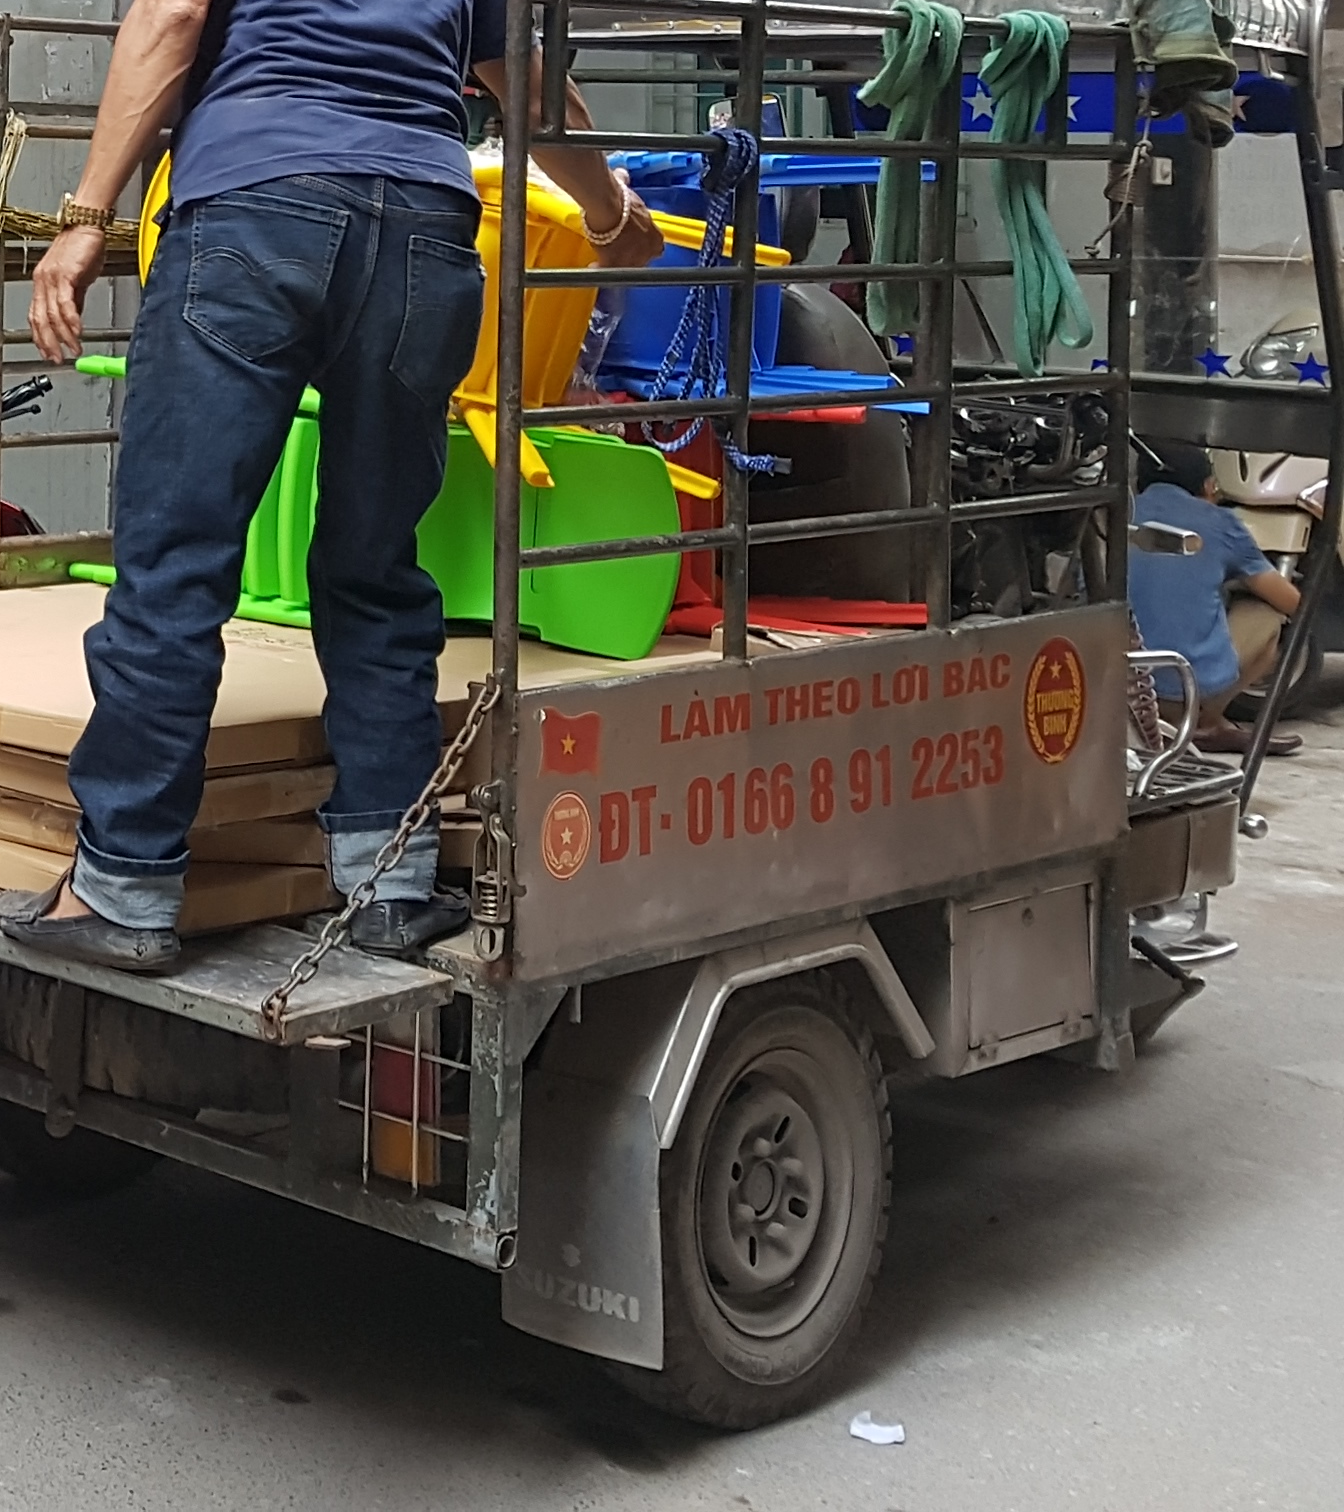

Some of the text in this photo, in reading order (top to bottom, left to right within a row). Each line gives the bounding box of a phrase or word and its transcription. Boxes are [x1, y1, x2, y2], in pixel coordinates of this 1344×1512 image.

[764, 676, 861, 727] THEO
[687, 762, 795, 847] 0166
[810, 756, 834, 824] 8
[848, 744, 892, 814] 91
[911, 725, 1005, 801] 2253
